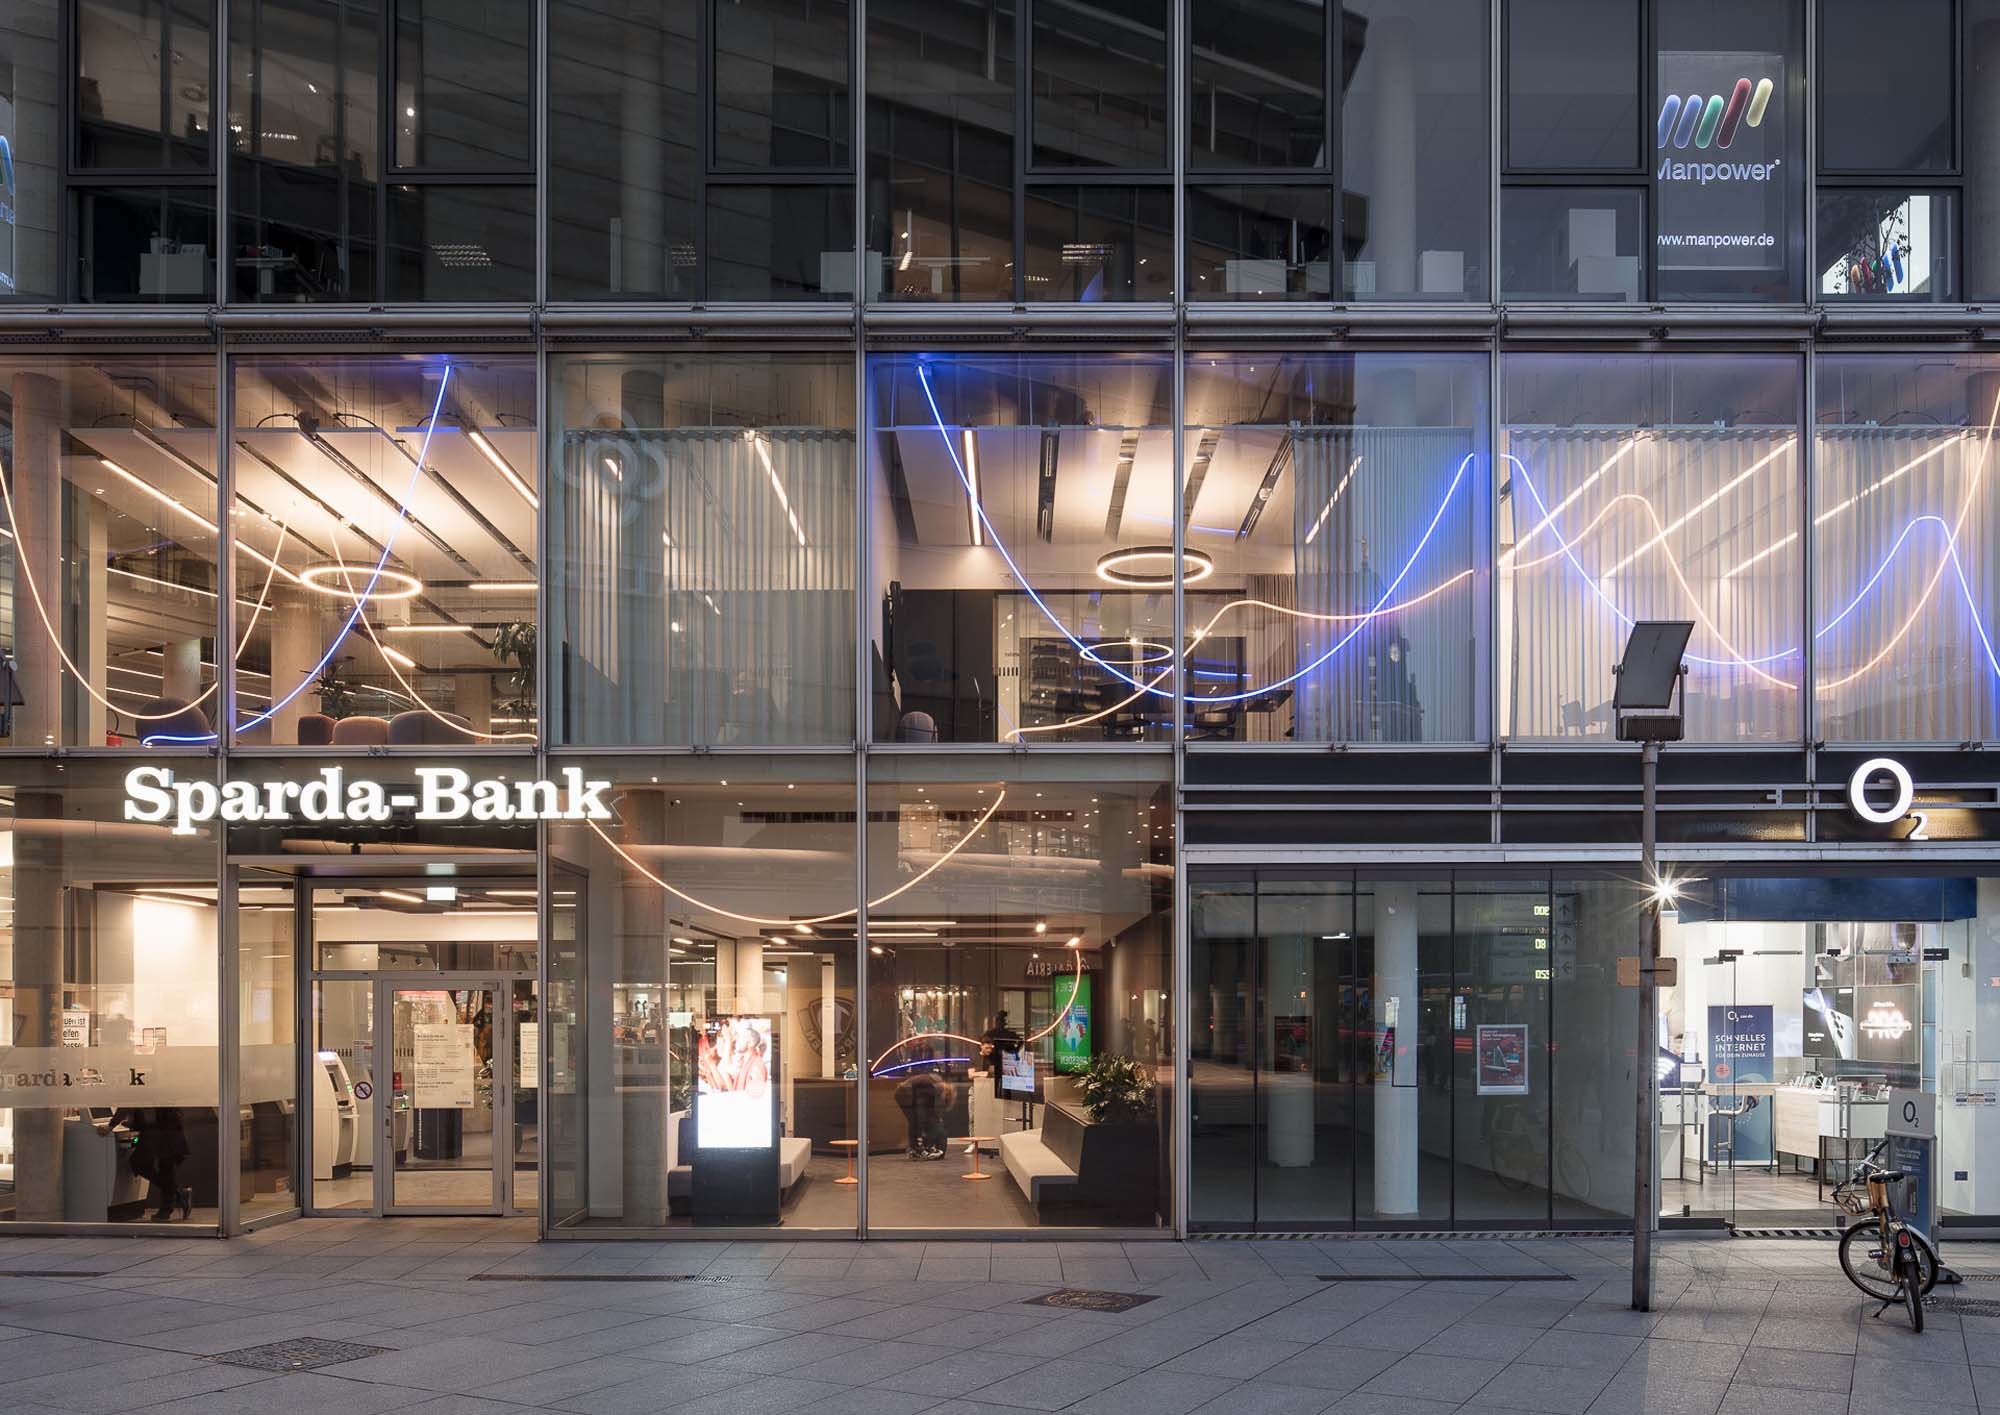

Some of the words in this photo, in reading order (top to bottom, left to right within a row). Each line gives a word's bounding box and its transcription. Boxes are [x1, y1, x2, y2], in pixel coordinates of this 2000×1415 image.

[1657, 158, 1774, 185] Manpower
[124, 766, 611, 835] Sparda-Bank
[1715, 1034, 1766, 1042] SCHNELLES
[1715, 1043, 1766, 1051] INTERNET
